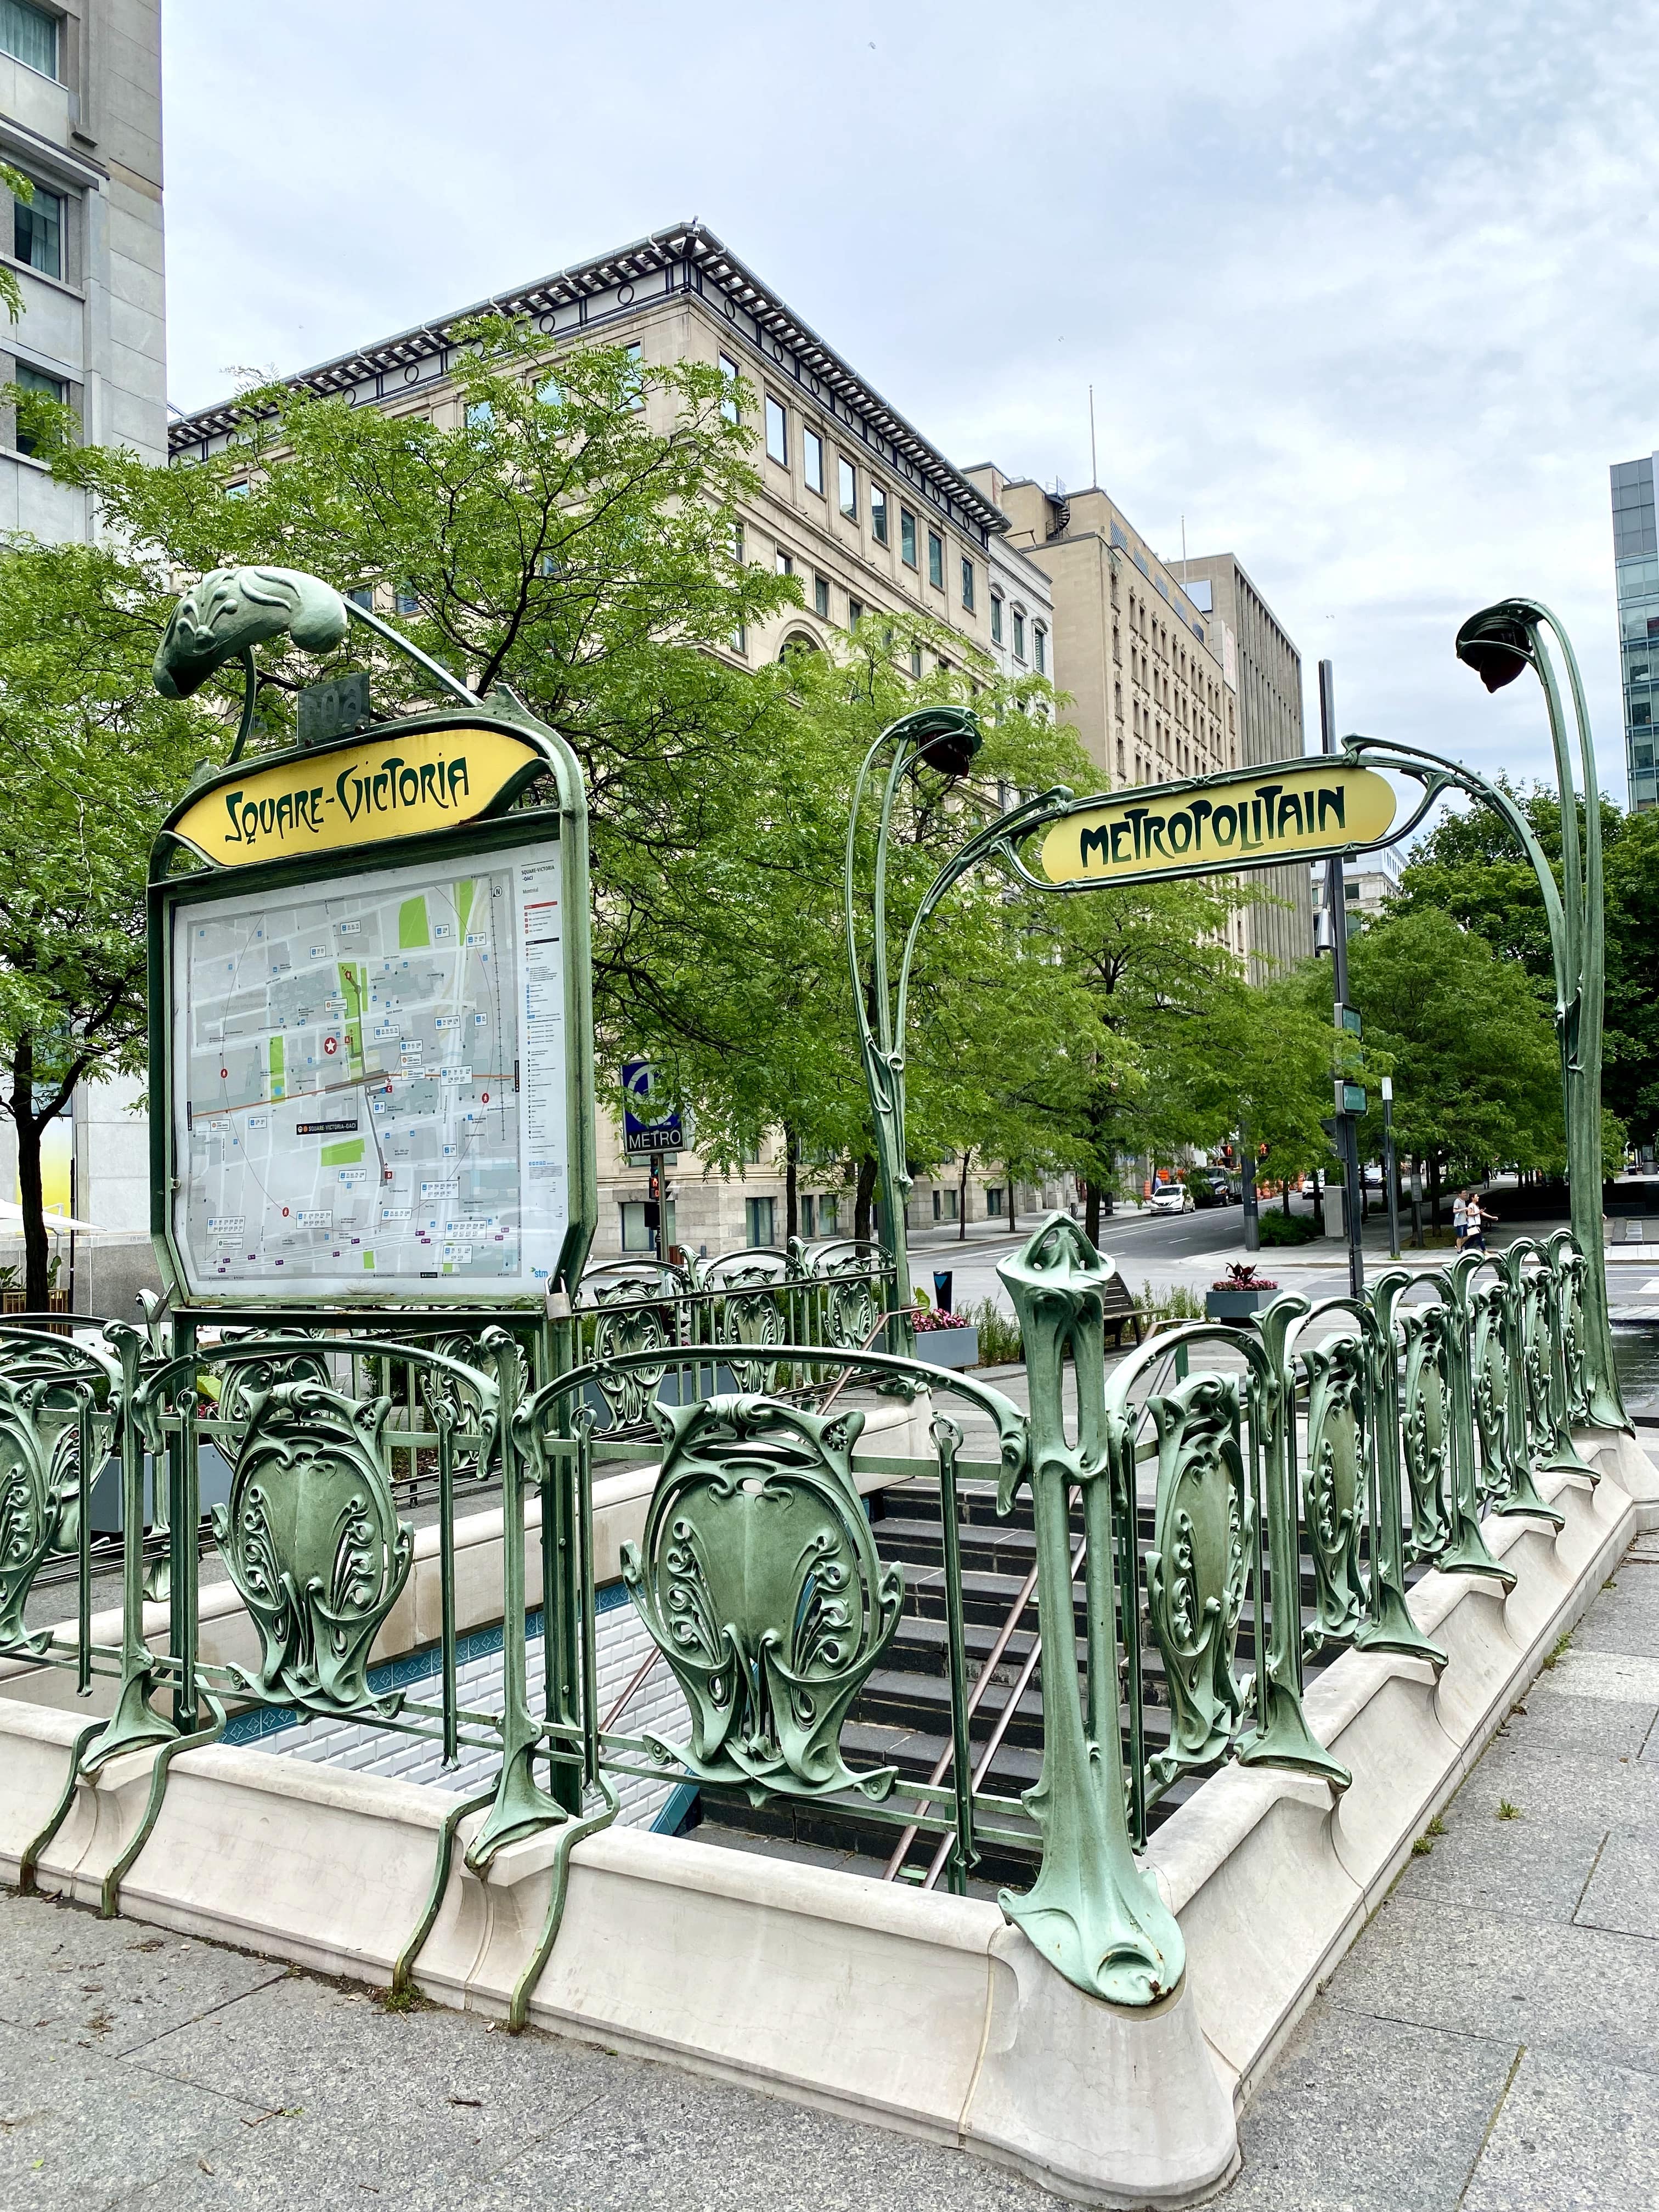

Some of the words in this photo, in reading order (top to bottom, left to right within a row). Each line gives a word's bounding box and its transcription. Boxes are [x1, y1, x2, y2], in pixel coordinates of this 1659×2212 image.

[1080, 785, 1346, 868] METROPOLITAIN
[521, 865, 555, 876] SQUARE-VICTORIA
[629, 1129, 681, 1149] METRO
[534, 1269, 548, 1278] stm
